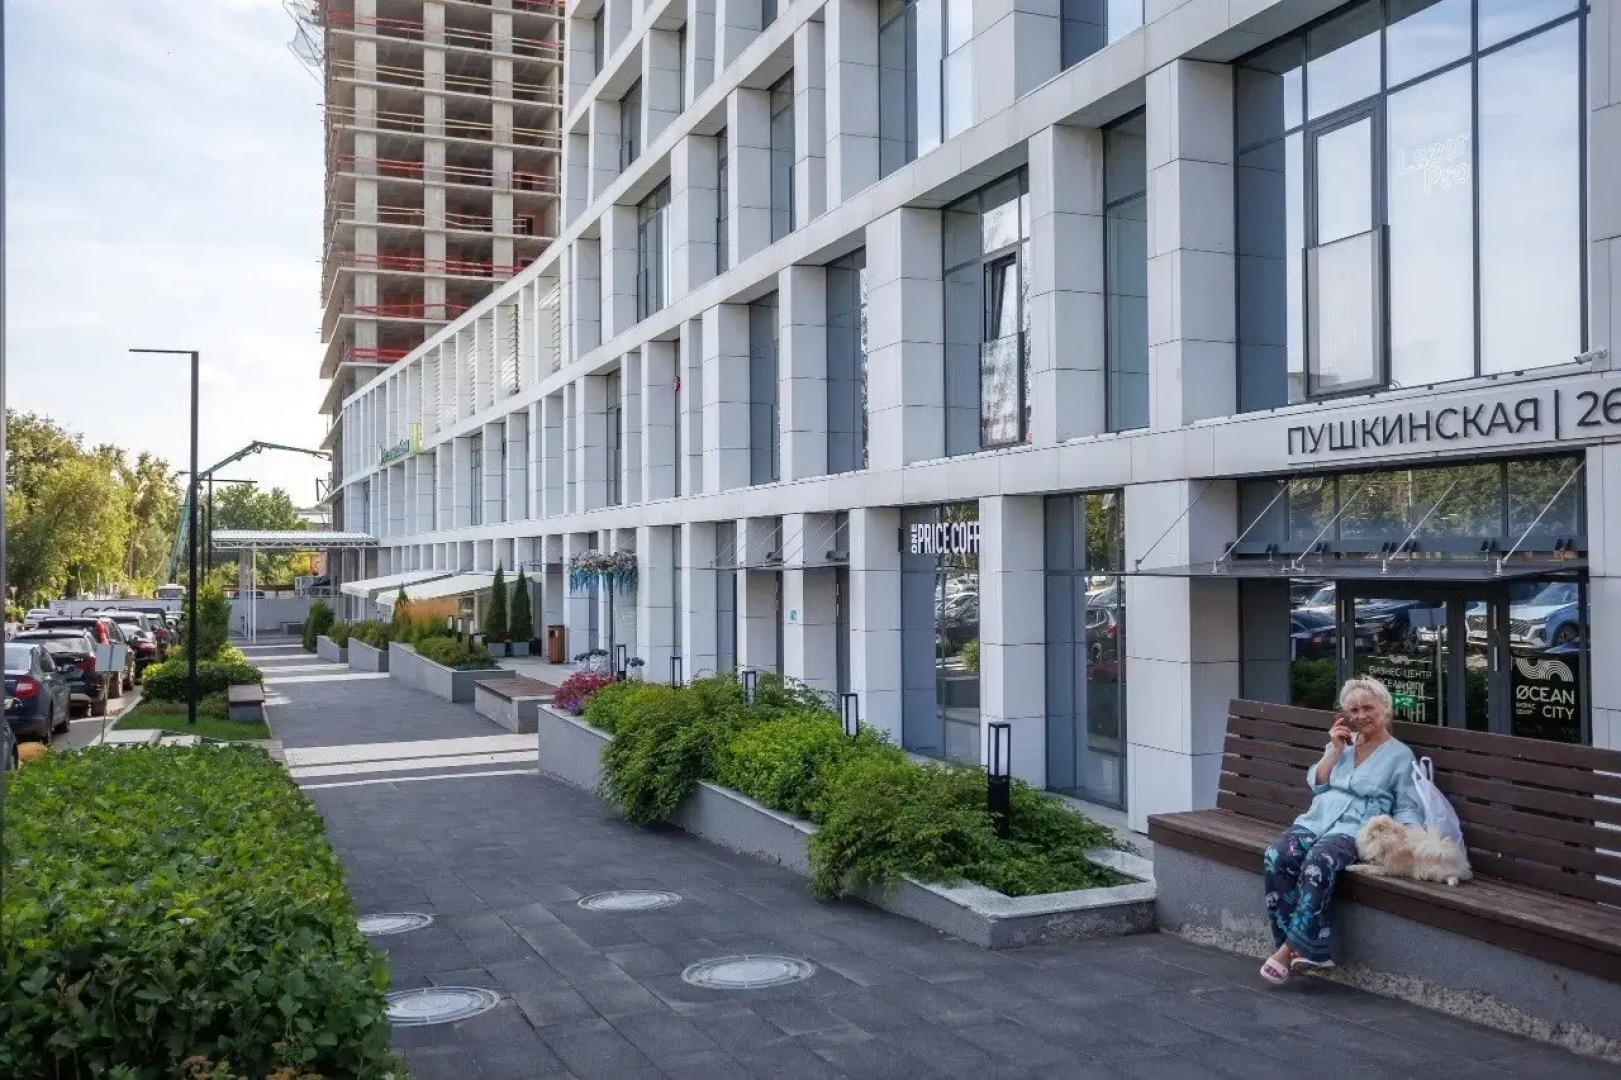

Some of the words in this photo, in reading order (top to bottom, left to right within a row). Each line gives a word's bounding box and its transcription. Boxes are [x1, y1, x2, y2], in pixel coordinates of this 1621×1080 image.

[1287, 397, 1539, 455] ПУШКИНСКАЯ
[1576, 387, 1621, 427] 26
[918, 523, 950, 554] PRICE
[1542, 704, 1575, 720] CITY
